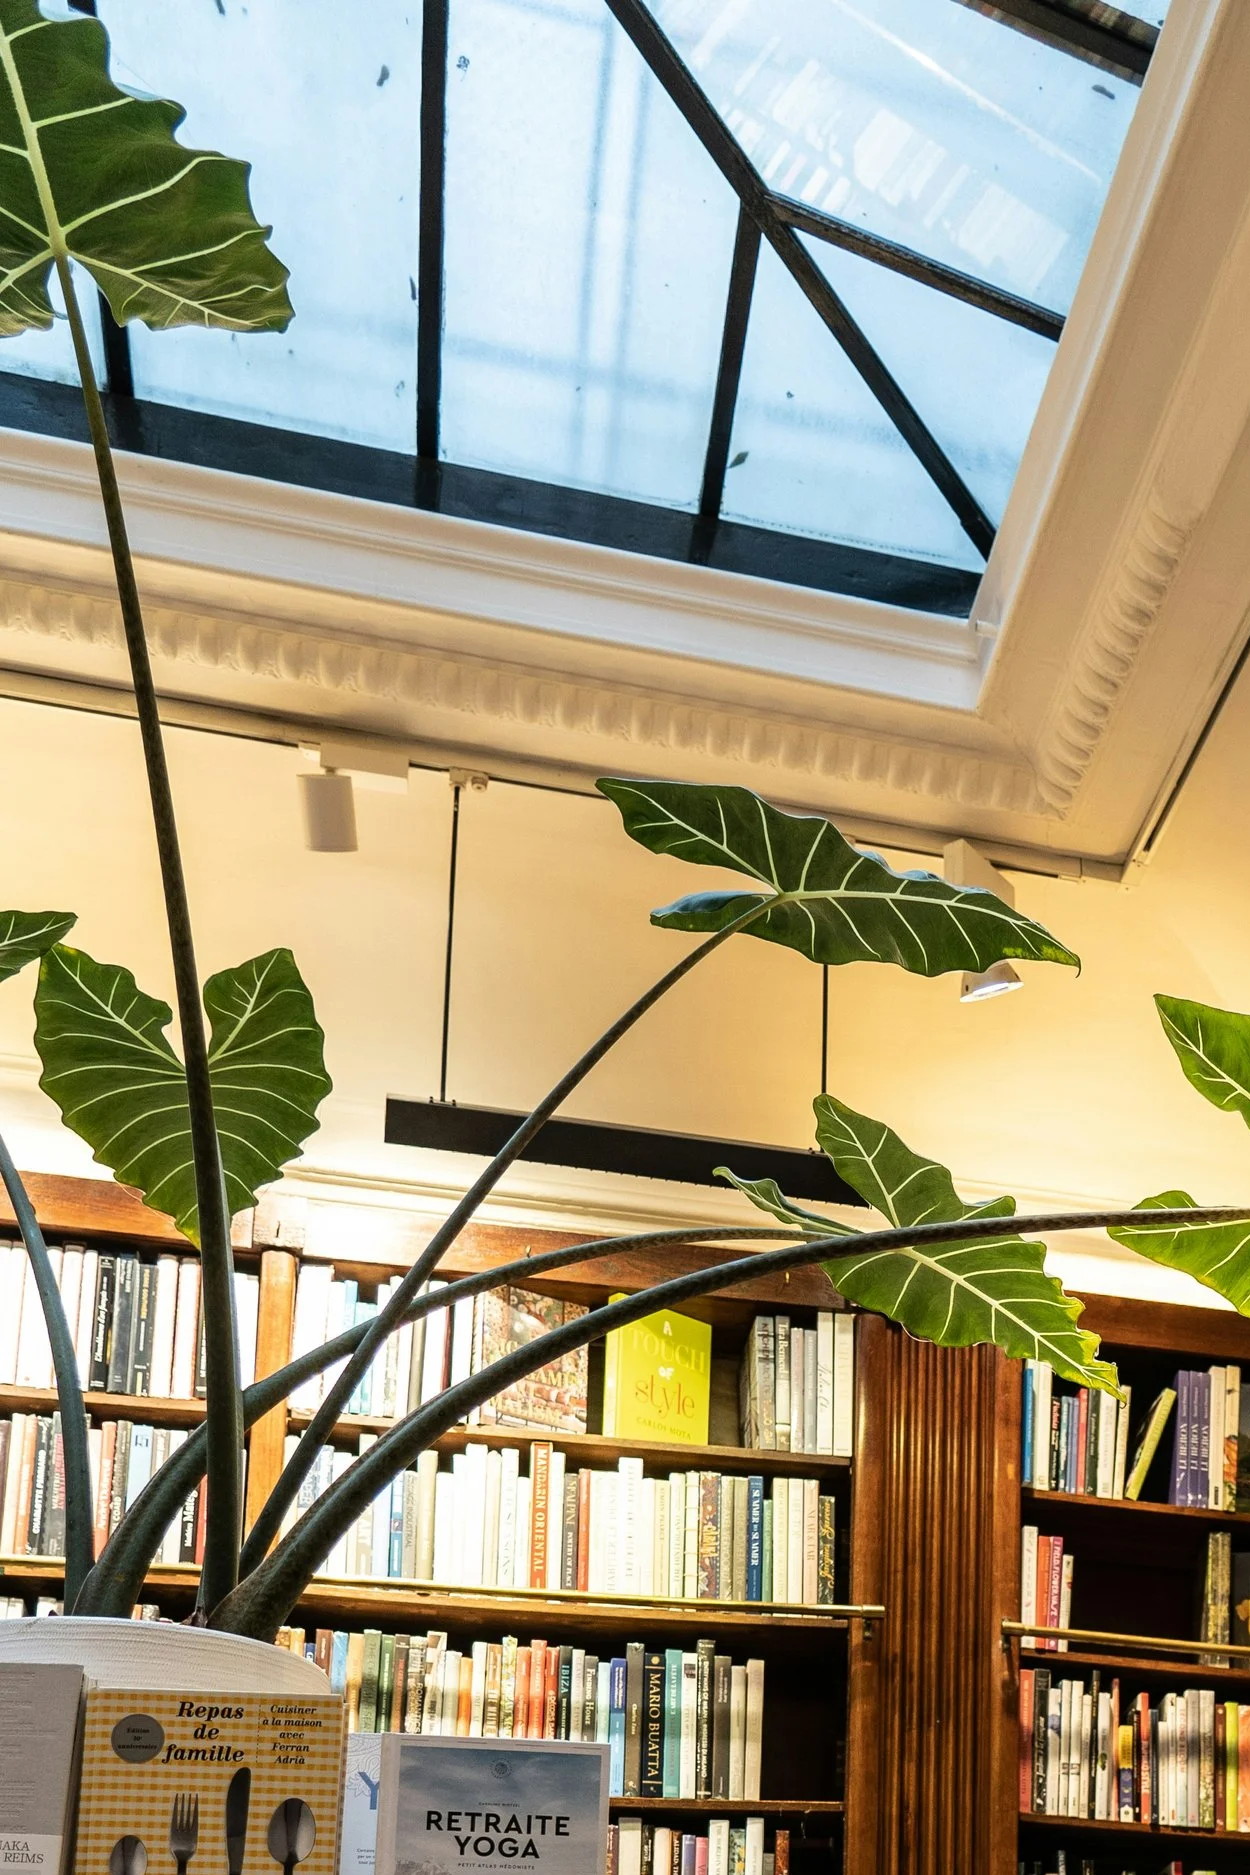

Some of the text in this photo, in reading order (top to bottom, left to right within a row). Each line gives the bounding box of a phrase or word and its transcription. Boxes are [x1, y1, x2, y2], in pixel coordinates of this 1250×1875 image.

[663, 1321, 672, 1336] A
[630, 1328, 705, 1373] TOUCH
[658, 1367, 674, 1379] OF
[635, 1375, 695, 1418] style
[636, 1417, 691, 1440] CARLOS MOTA
[534, 1448, 547, 1572] MANDARIN ORIENTAL
[176, 1701, 244, 1722] Repas
[270, 1704, 316, 1715] Cuisiner
[193, 1724, 219, 1740] de
[647, 1673, 661, 1777] MARIO BUATTA
[279, 1731, 304, 1740] avec
[162, 1744, 244, 1764] famille
[272, 1742, 309, 1752] Ferran
[274, 1755, 305, 1765] Adrià
[426, 1810, 570, 1836] RETRAITE
[454, 1836, 540, 1858] YOGA
[4, 1852, 44, 1864] REIMS
